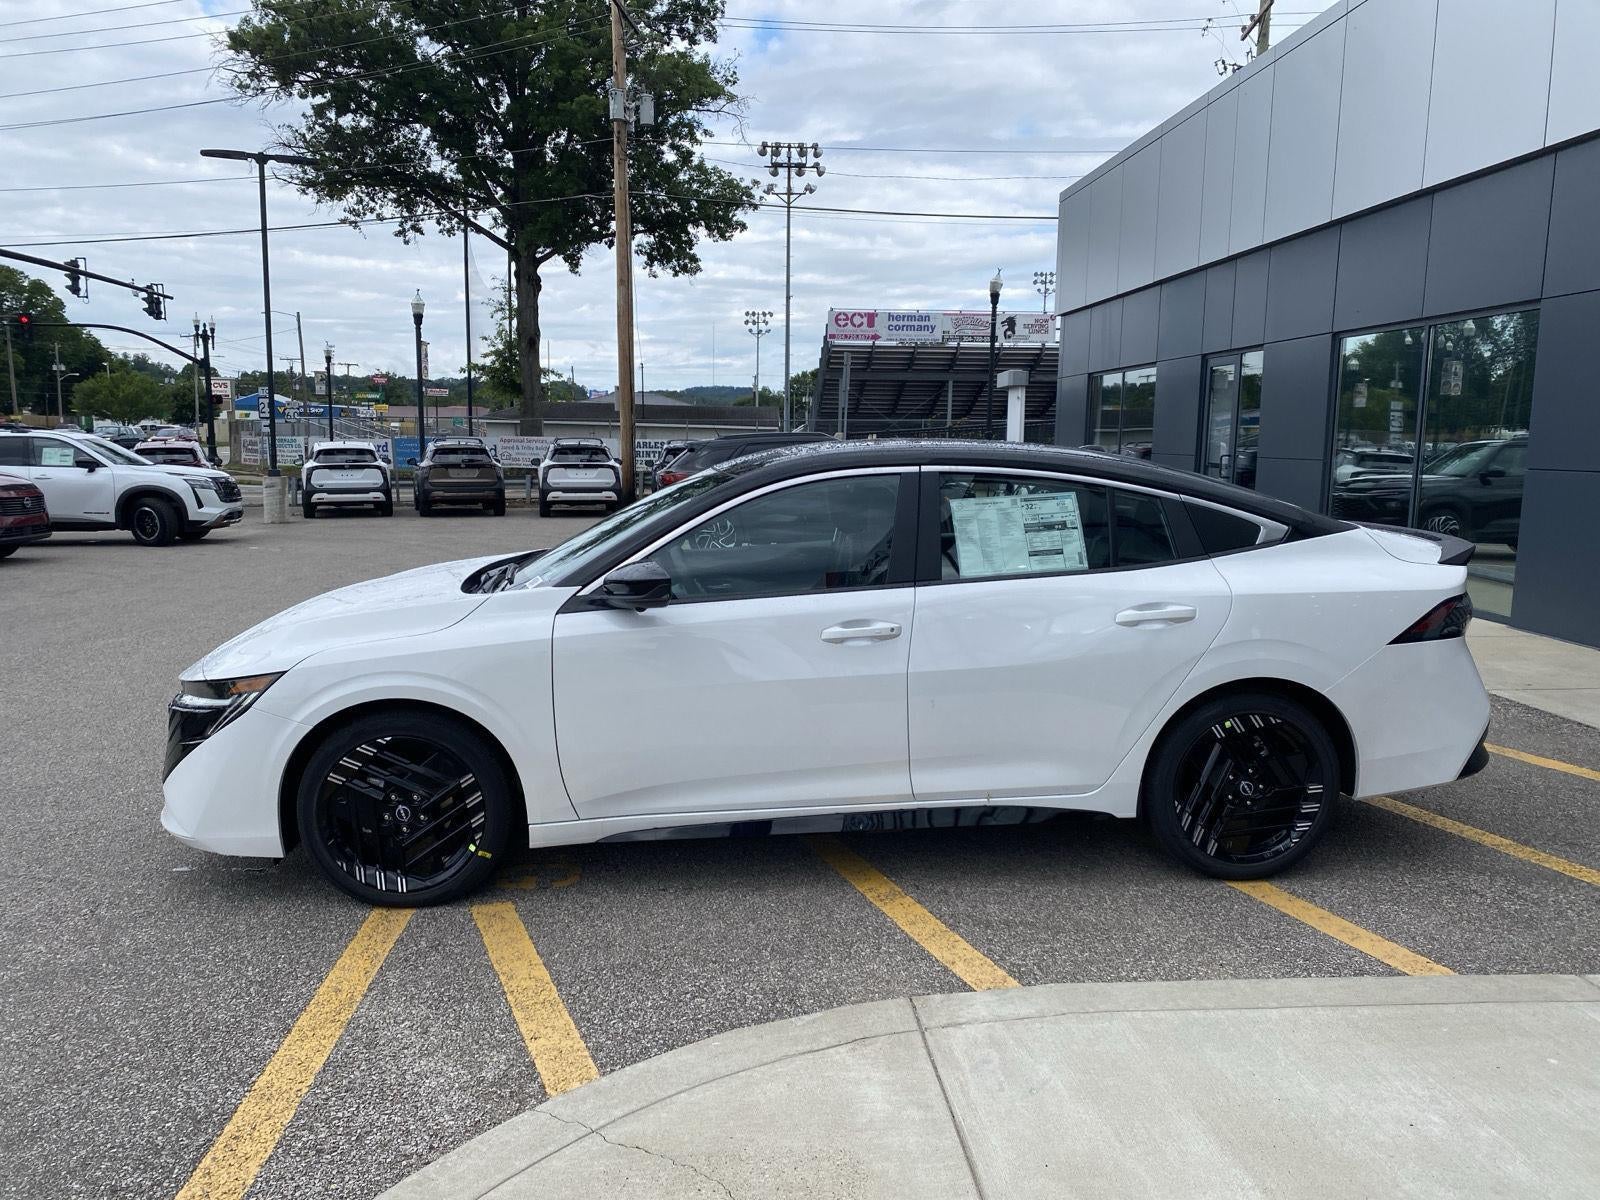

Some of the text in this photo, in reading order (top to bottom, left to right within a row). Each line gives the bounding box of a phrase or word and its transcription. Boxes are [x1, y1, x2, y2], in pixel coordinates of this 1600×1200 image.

[888, 312, 931, 322] herman
[887, 323, 937, 334] cormany
[259, 402, 270, 414] 2
[636, 441, 666, 450] ARLES
